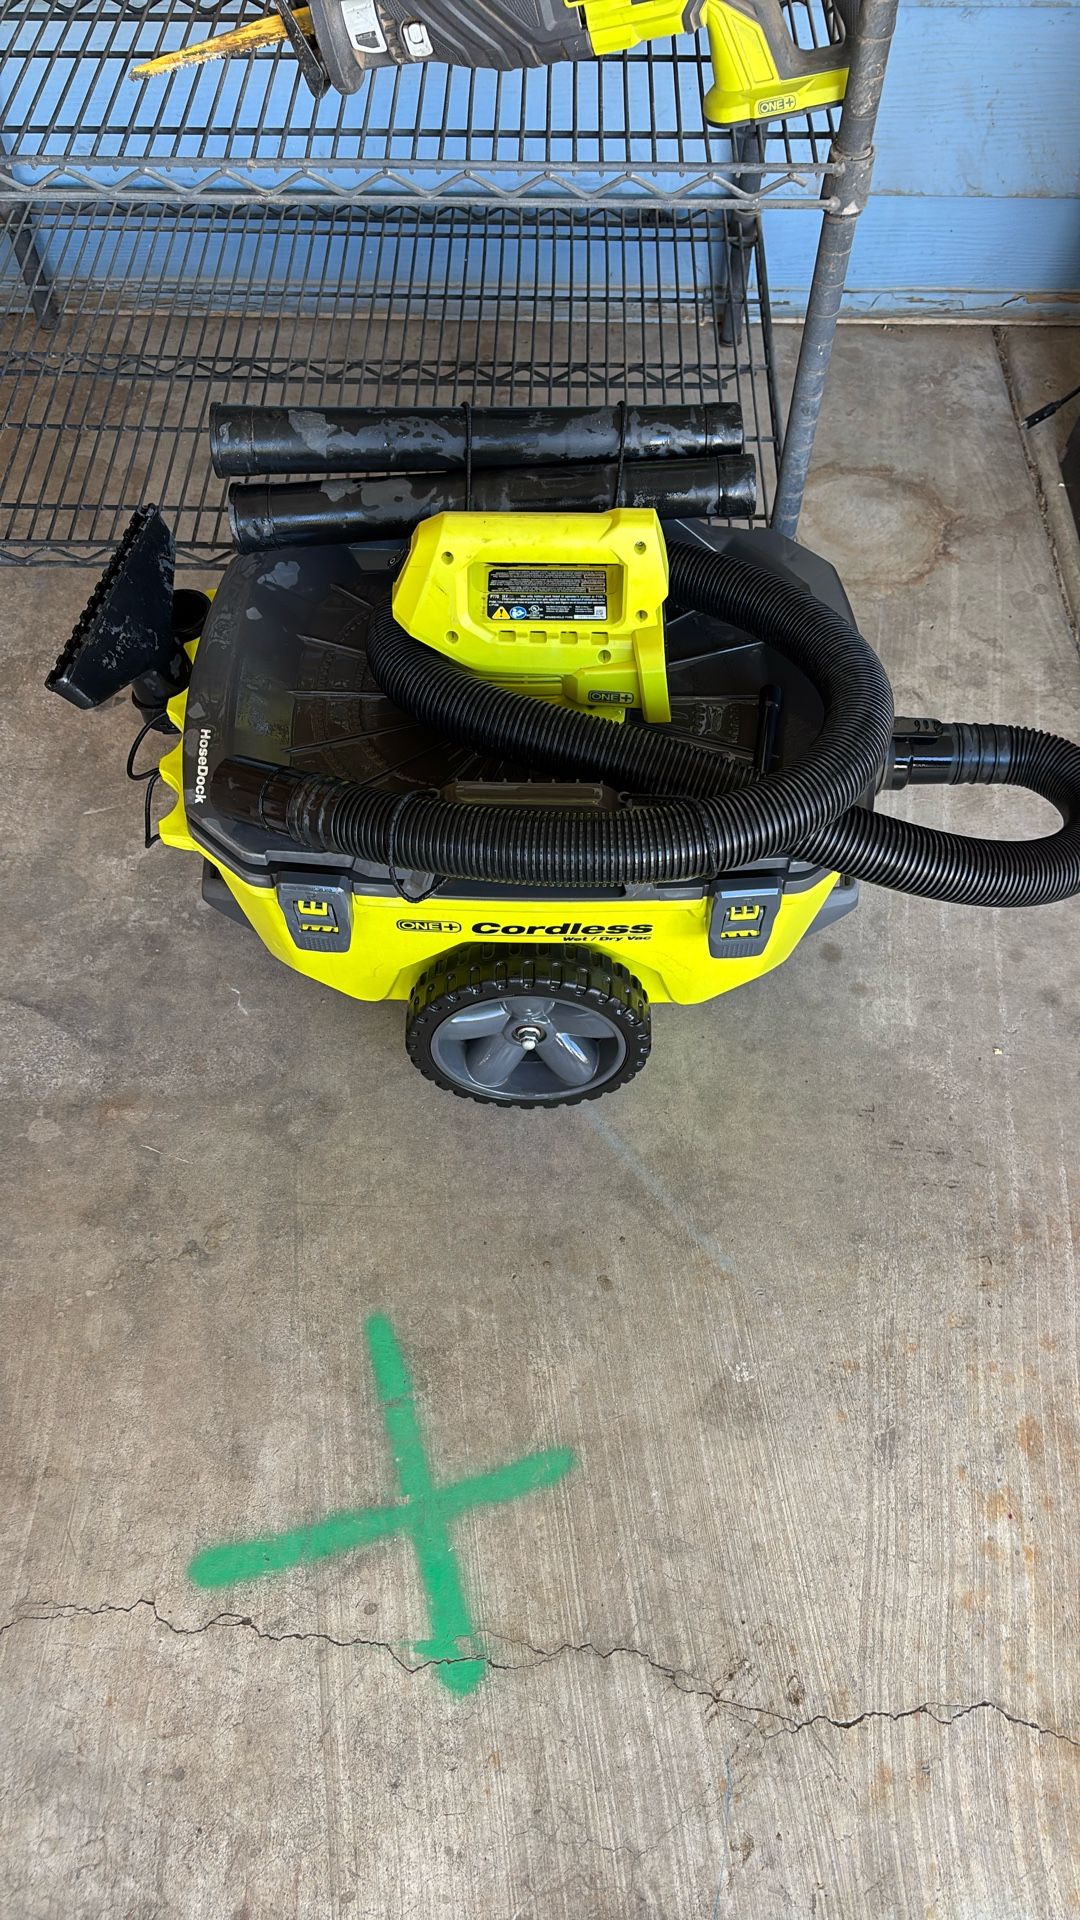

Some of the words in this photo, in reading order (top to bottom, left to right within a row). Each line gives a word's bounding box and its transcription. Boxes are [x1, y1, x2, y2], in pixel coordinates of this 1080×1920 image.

[759, 97, 795, 114] ONE+
[590, 692, 632, 703] ONE+
[194, 728, 211, 804] HoseDock
[399, 920, 460, 933] ONE+
[471, 922, 653, 934] Cordless
